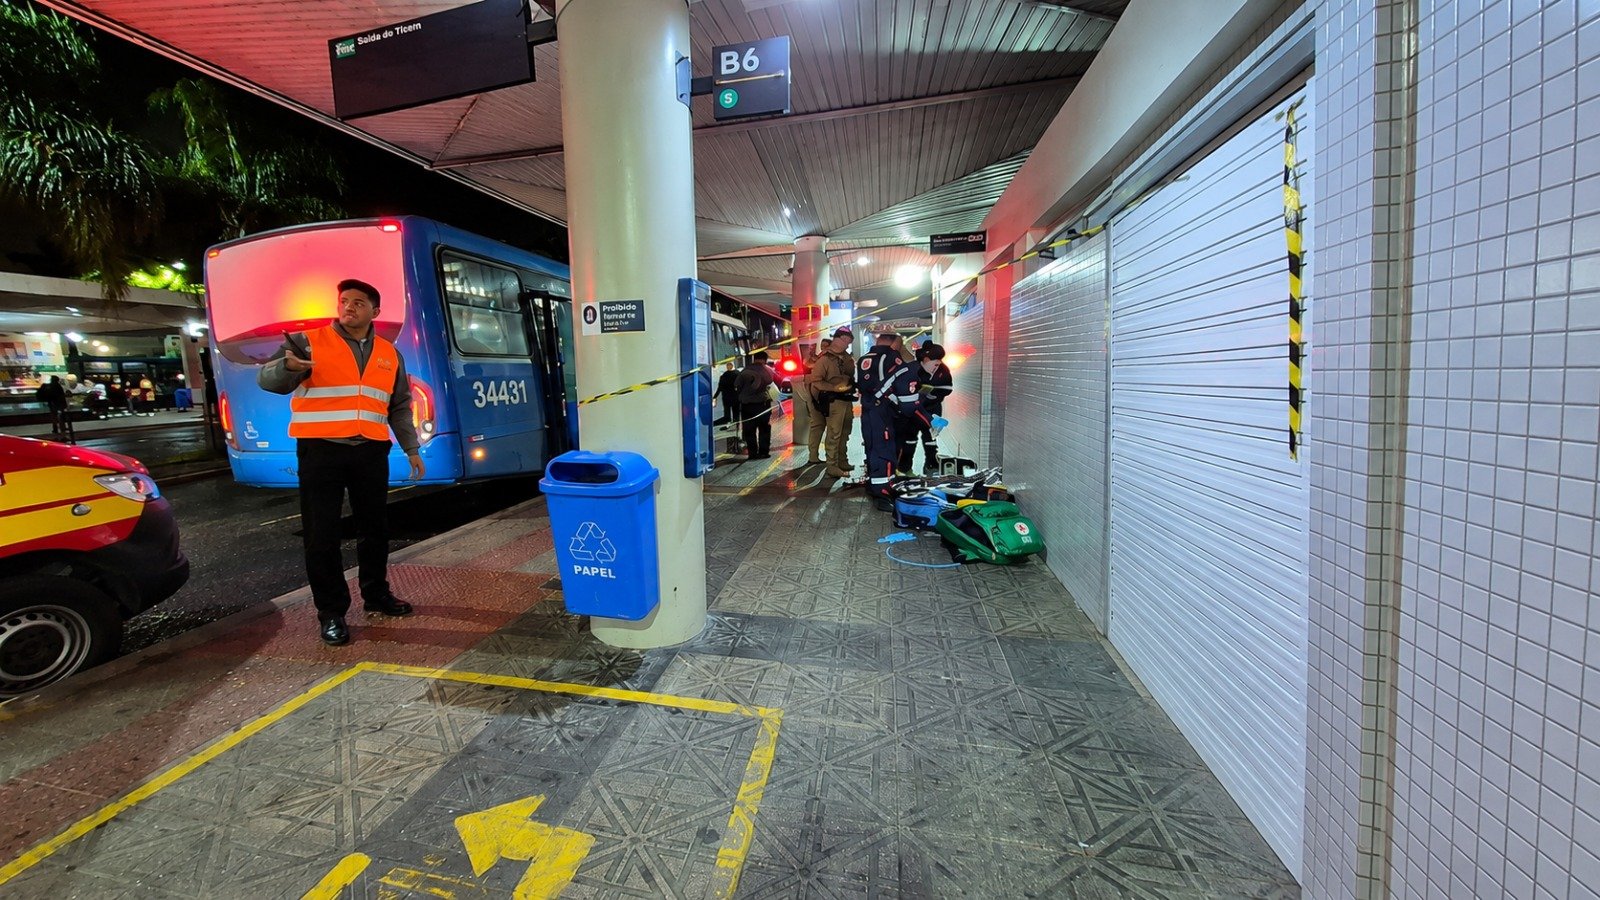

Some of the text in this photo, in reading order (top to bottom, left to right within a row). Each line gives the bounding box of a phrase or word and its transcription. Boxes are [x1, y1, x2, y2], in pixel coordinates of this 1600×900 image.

[382, 30, 394, 39] do
[721, 47, 760, 75] B6
[724, 92, 733, 104] S
[602, 303, 637, 312] Proibido
[472, 380, 527, 408] 34431
[573, 564, 617, 579] PAPEL
